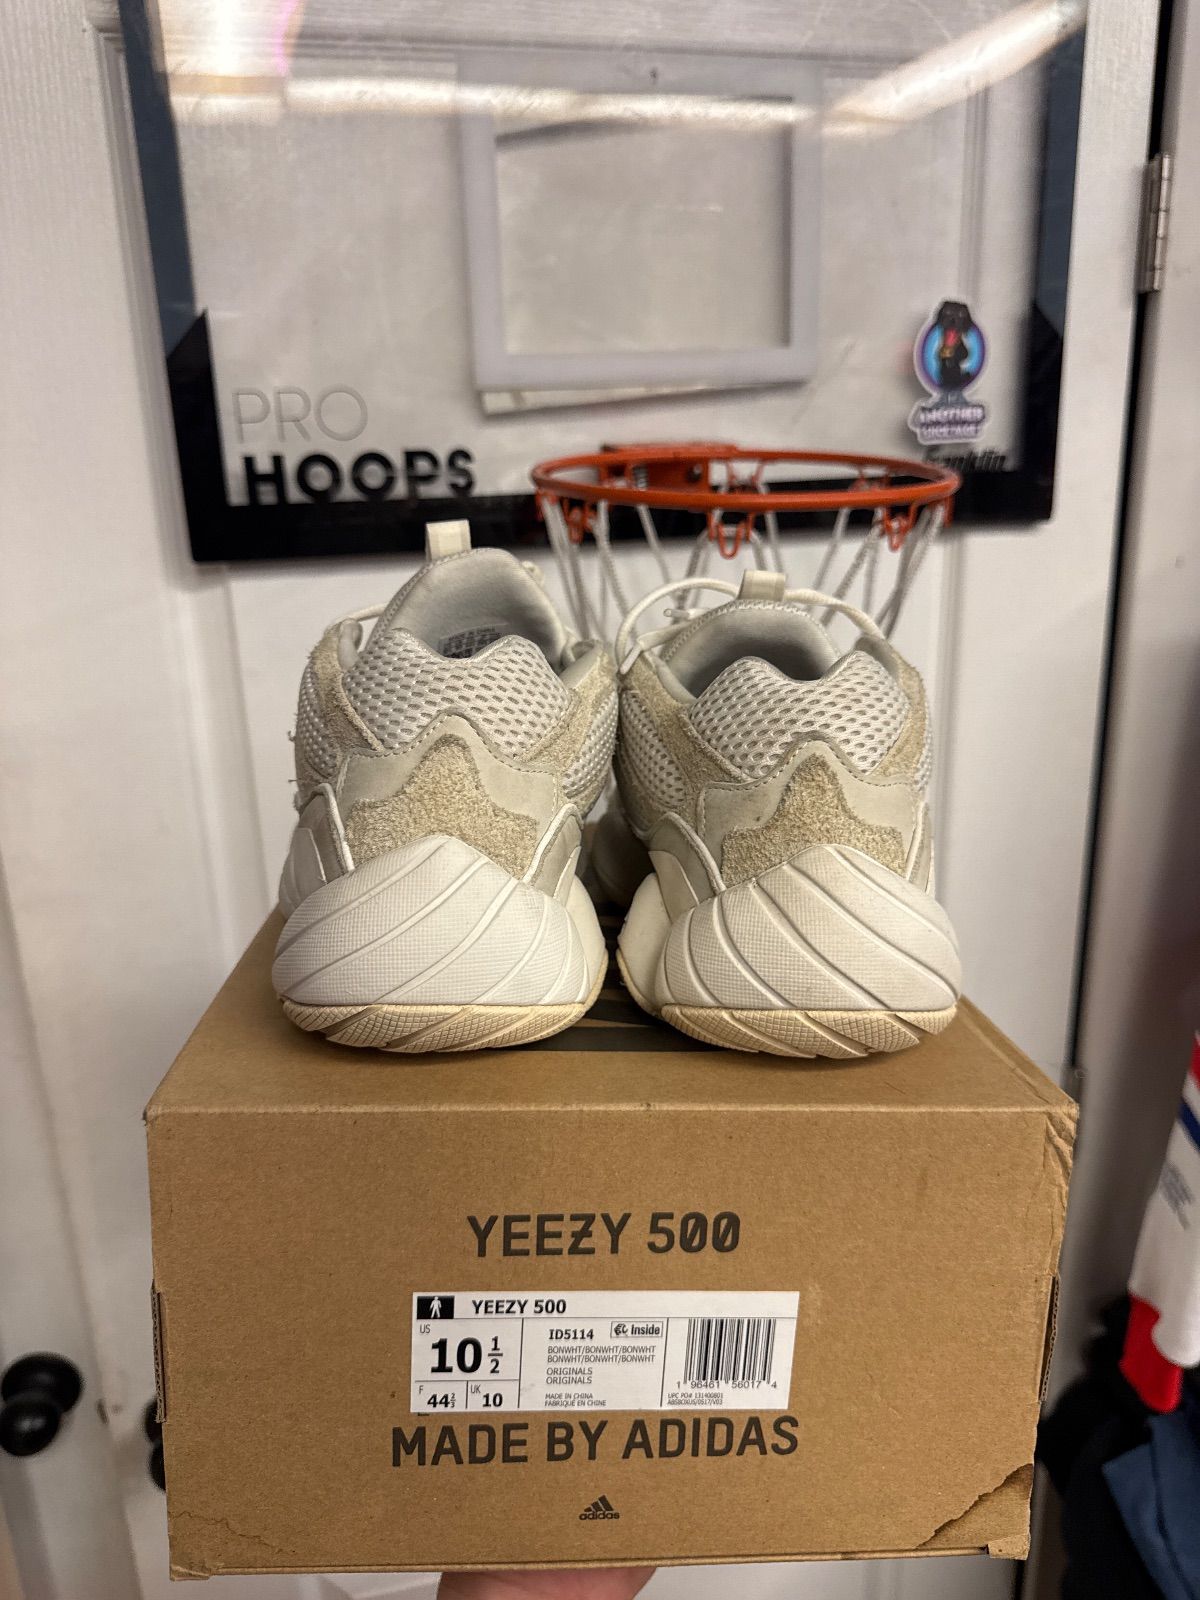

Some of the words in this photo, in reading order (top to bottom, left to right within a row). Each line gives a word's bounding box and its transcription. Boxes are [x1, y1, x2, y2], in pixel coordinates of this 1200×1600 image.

[231, 384, 368, 443] PRO
[243, 448, 475, 506] HOOPS
[467, 1212, 632, 1258] YEEZY
[647, 1211, 741, 1254] 500
[472, 1299, 529, 1314] YEEZY
[533, 1299, 567, 1314] 500
[419, 1324, 431, 1334] US
[549, 1328, 594, 1340] ID5114
[631, 1324, 660, 1335] Inside
[430, 1337, 483, 1374] 10
[547, 1345, 656, 1355] BONWHT/BONWHT/BONWHT
[547, 1354, 655, 1364] BONWHT/BONWHT/BONWHT
[546, 1367, 593, 1376] ORIGINALS
[545, 1376, 592, 1385] ORIGINALS
[690, 1380, 721, 1389] 96461
[731, 1380, 761, 1389] 56017
[419, 1385, 424, 1394] F
[470, 1385, 481, 1394] UK
[427, 1394, 450, 1408] 44
[482, 1393, 503, 1408] 10
[392, 1422, 529, 1466] MADE
[547, 1420, 608, 1462] BY
[622, 1415, 799, 1459] ADIDAS
[579, 1511, 620, 1520] adidas
